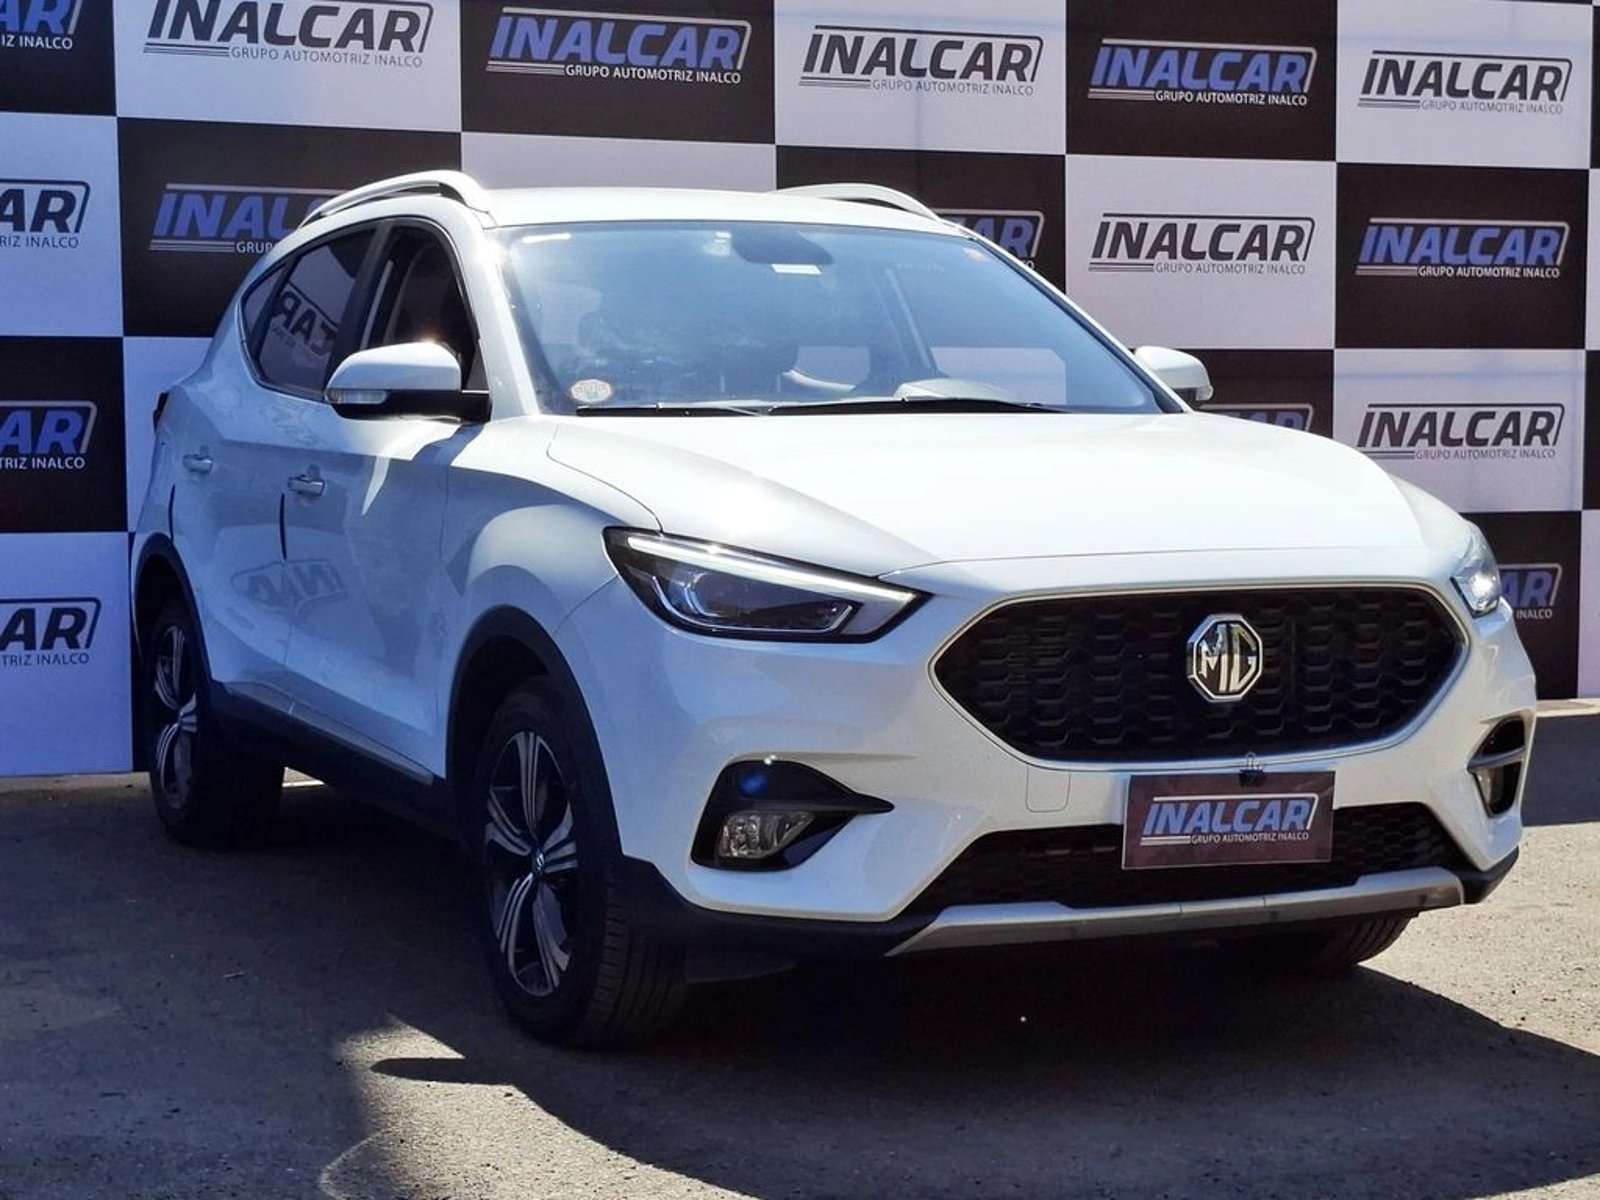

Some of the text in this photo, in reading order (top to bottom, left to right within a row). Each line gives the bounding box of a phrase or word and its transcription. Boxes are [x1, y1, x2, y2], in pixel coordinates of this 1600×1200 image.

[148, 0, 421, 52] INALCAR
[20, 35, 73, 49] INALCO
[489, 16, 740, 69] INALCAR
[231, 47, 423, 68] GRUPO AUTOMOTRIZ INALCO
[802, 33, 1032, 82] INALCAR
[566, 64, 741, 84] GRUPO AUTOMOTRIZ INALCO
[1091, 47, 1307, 92] INALCAR
[872, 79, 1034, 97] GRUPO AUTOMOTRIZ INALCO
[1361, 58, 1563, 102] INALCAR
[1155, 90, 1307, 106] GRUPO AUTOMOTRIZ INALCO
[1421, 99, 1563, 115] GRUPO AUTOMOTRIZ INALCO
[153, 192, 330, 239] INAL
[26, 236, 79, 249] INALCO
[236, 241, 277, 254] GRUP
[1091, 221, 1305, 262] INALCAR
[1358, 225, 1561, 266] INALCAR
[1155, 263, 1306, 276] GRUPO AUTOMOTRIZ INALCO
[1418, 265, 1560, 279] GRUPO AUTOMOTRIZ INALCO
[1356, 410, 1556, 447] INALCAR
[32, 457, 86, 469] INALCO
[1415, 448, 1556, 460] GRUPO AUTOMOTRIZ INALCO
[1516, 608, 1553, 620] INALCO
[37, 652, 90, 664] INALCO
[1199, 623, 1257, 693] MG
[1143, 800, 1312, 836] INALCAR
[1191, 834, 1221, 845] GRUPO
[1222, 833, 1277, 844] AUTOMOTRIZ
